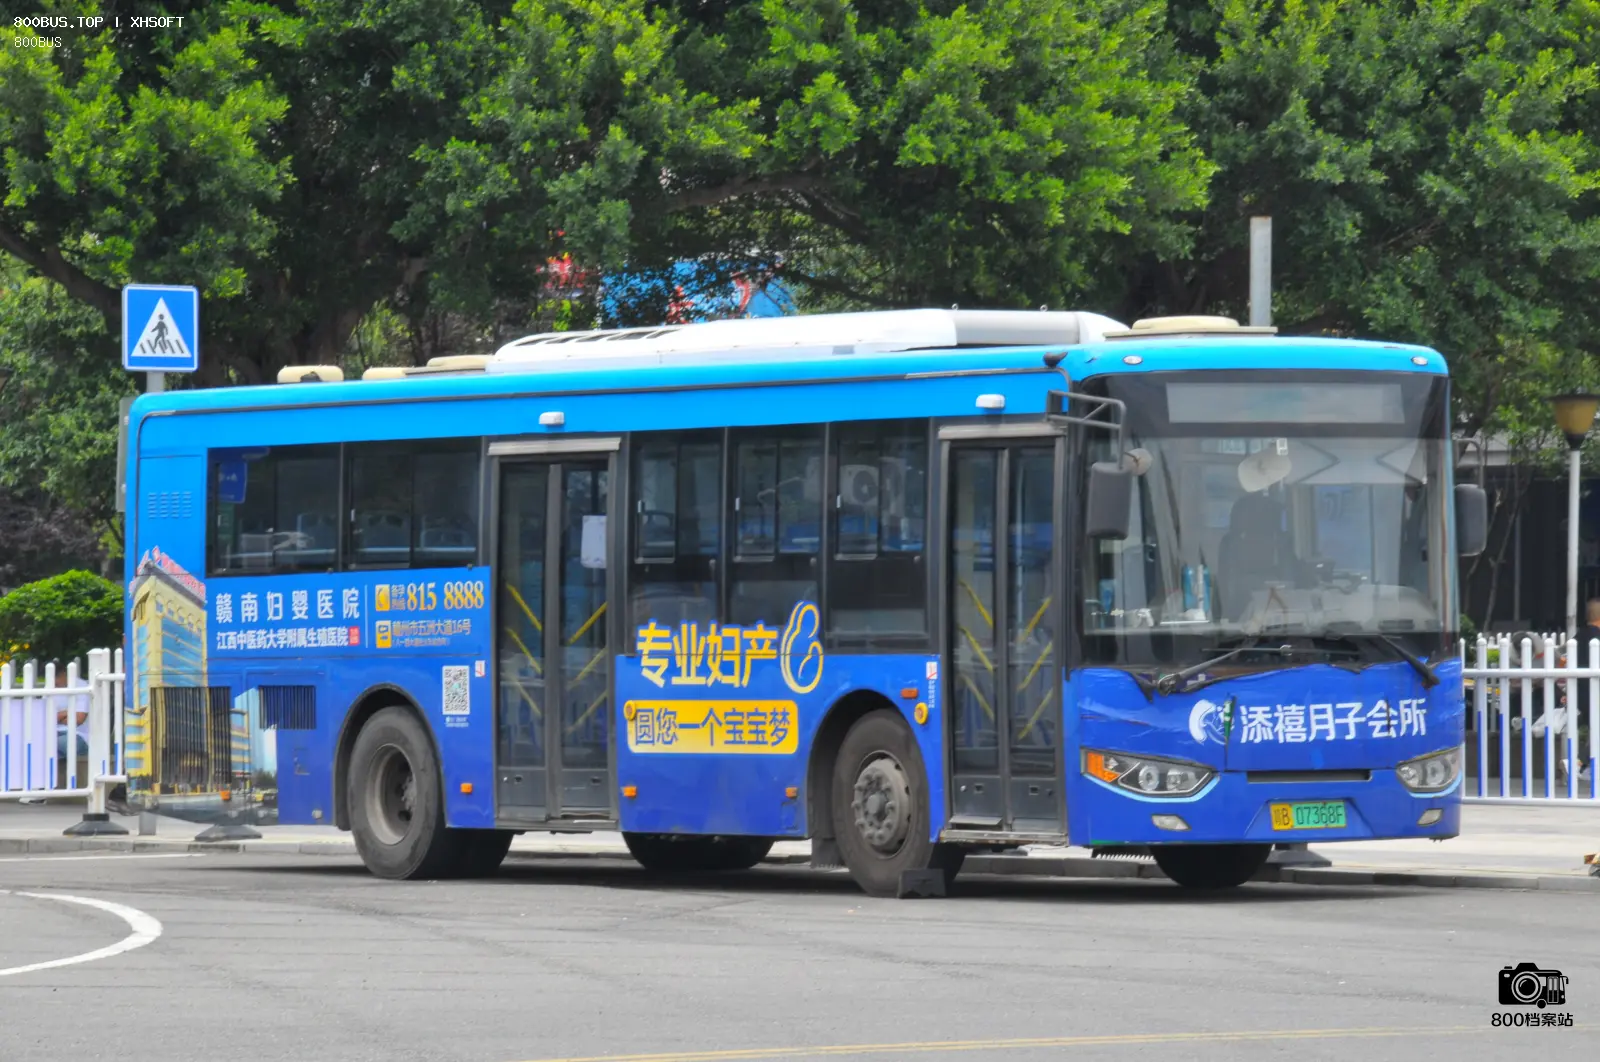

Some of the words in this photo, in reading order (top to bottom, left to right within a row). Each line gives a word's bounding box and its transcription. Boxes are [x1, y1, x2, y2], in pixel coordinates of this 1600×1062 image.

[215, 587, 360, 624] 赣南妇婴医院
[407, 582, 437, 611] 815
[443, 580, 485, 610] 8888
[637, 621, 779, 688] 专业妇产
[634, 707, 791, 747] 圆您一个宝宝梦
[1239, 697, 1427, 744] 添禧月子会所
